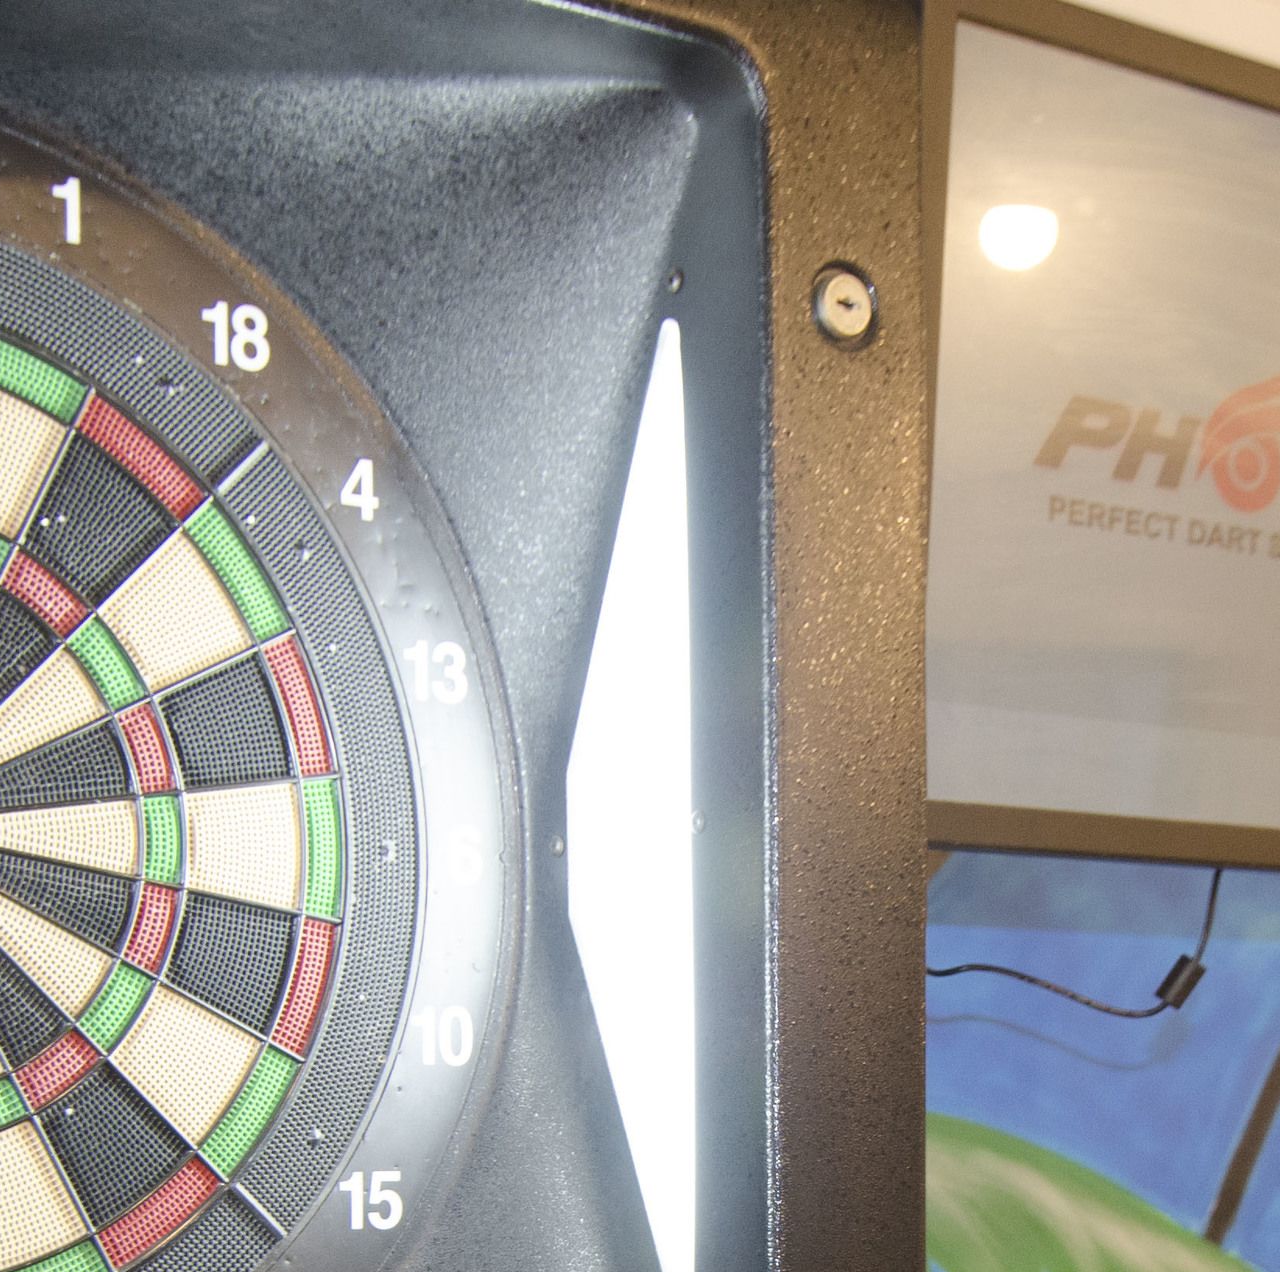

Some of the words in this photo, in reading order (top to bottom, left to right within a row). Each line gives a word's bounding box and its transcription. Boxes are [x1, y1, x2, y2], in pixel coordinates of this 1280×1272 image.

[51, 178, 81, 245] 1
[201, 301, 271, 373] 18
[340, 459, 380, 522] 4
[1048, 495, 1182, 541] PERFECT
[1186, 519, 1261, 556] DART
[402, 640, 468, 704] 13
[413, 1005, 474, 1067] 10
[338, 1169, 404, 1231] 15
